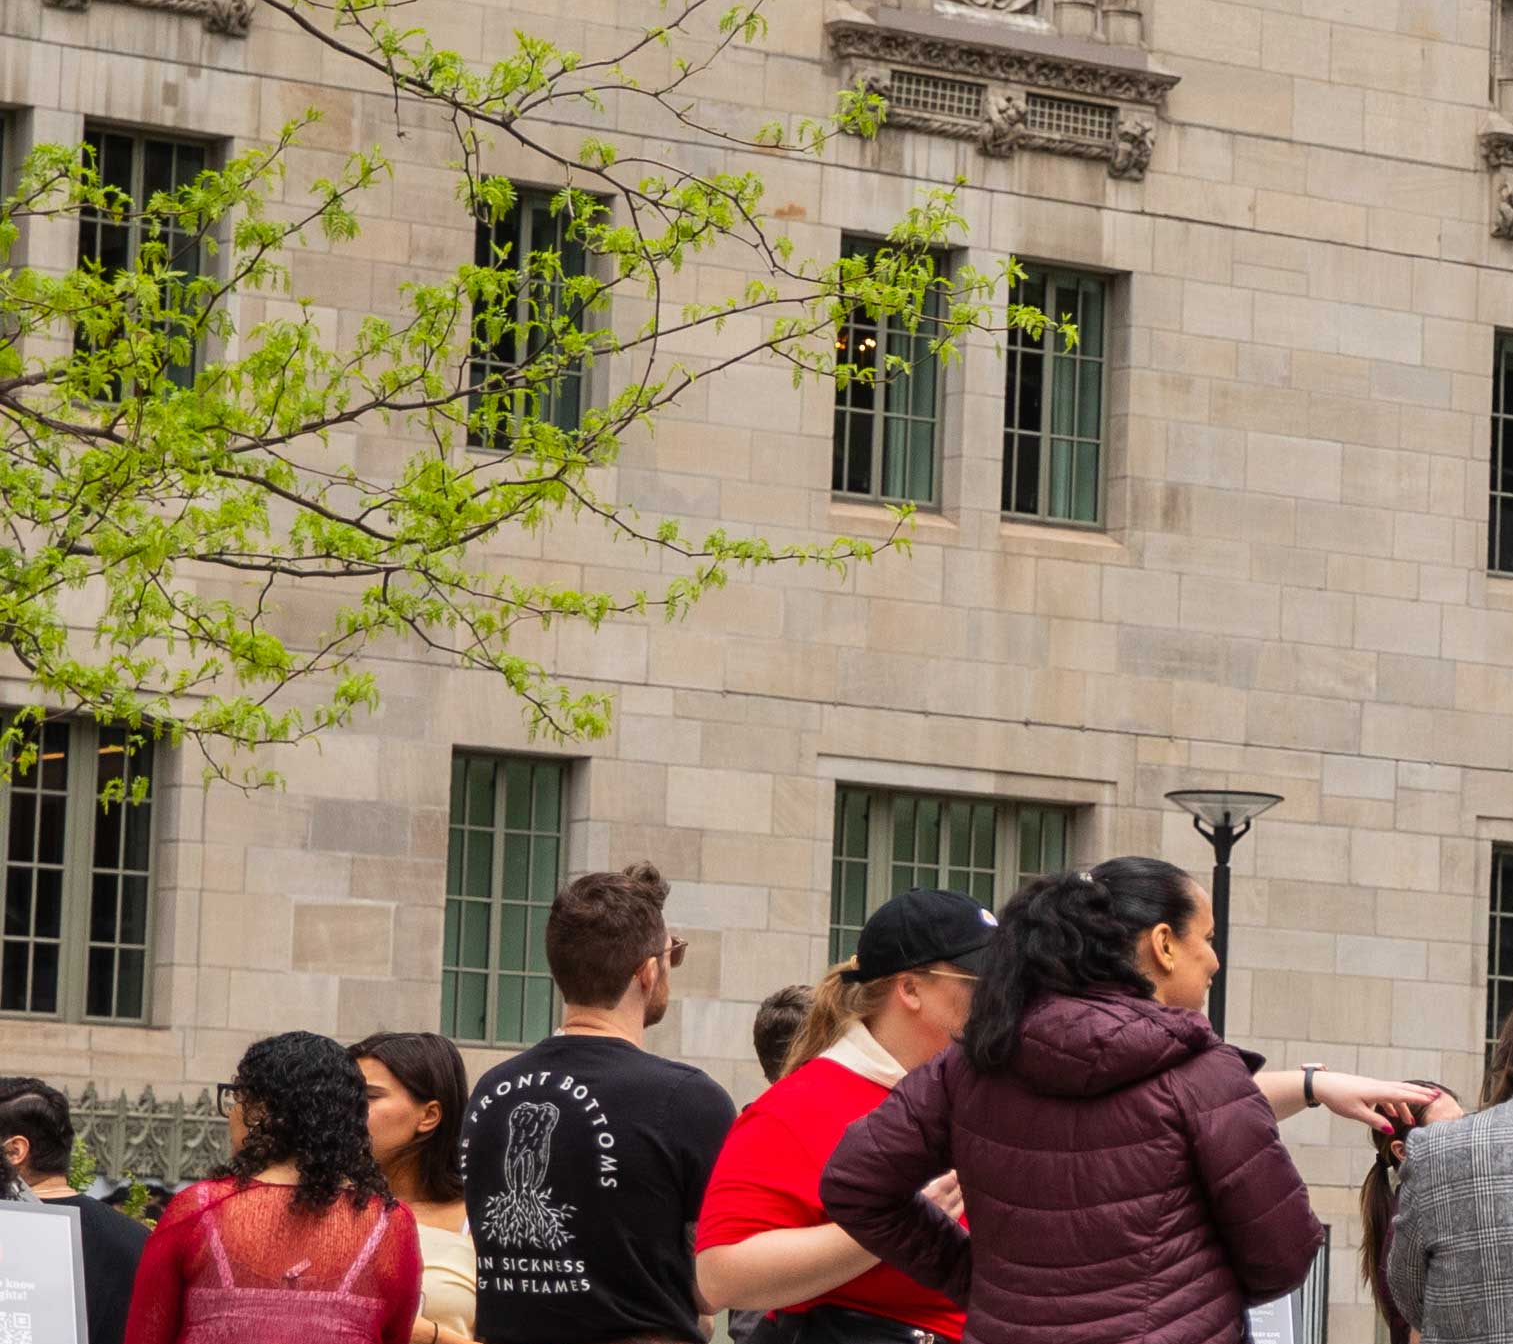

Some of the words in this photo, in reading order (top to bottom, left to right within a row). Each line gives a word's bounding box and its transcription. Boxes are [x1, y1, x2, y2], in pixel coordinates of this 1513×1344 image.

[471, 1072, 551, 1123] FRONT
[560, 1076, 618, 1188] BOTTOMS
[478, 1257, 493, 1269] IN
[502, 1258, 585, 1273] SICKNESS
[478, 1278, 488, 1290] &
[496, 1278, 514, 1291] IN
[522, 1279, 590, 1293] FLAMES
